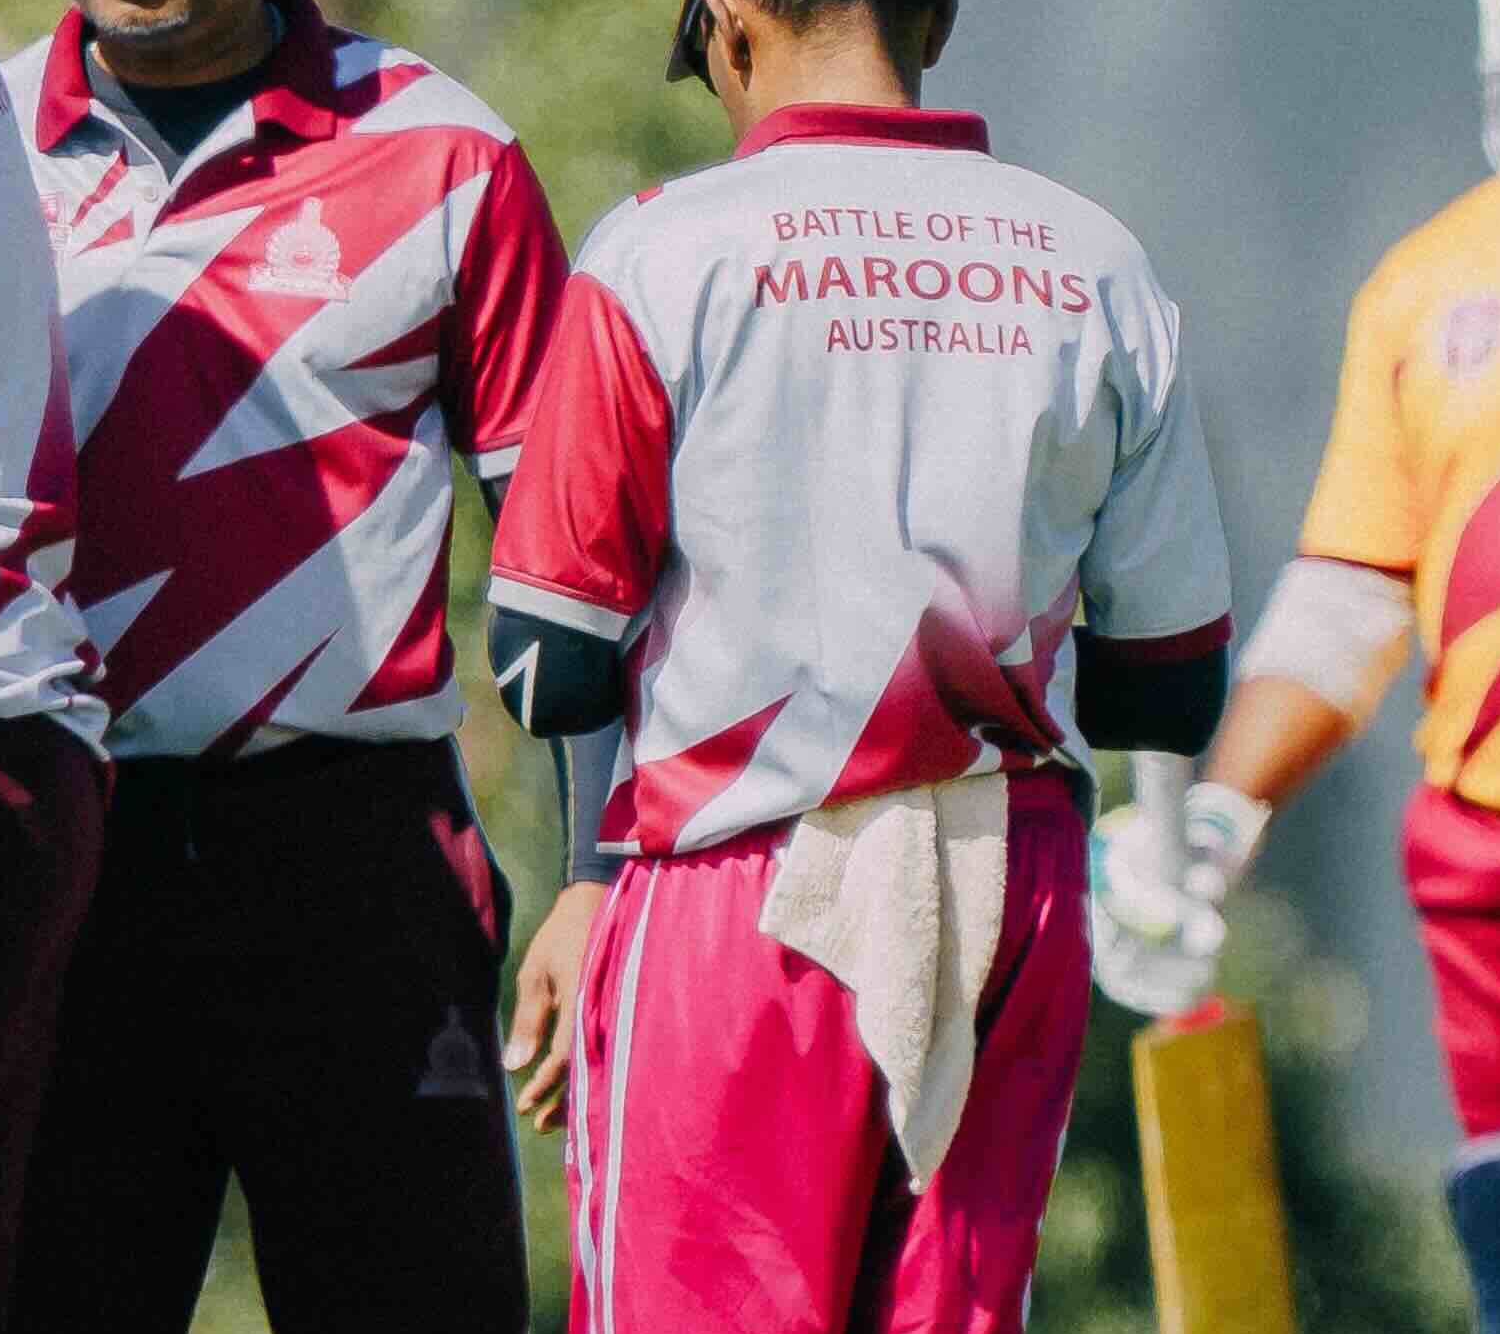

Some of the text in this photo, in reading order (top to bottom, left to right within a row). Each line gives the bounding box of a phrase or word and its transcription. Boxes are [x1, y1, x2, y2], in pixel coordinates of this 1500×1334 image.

[771, 207, 1057, 253] BATTLE OF THE
[752, 255, 1093, 314] MAROONS
[825, 317, 1034, 356] AUSTRALIA
